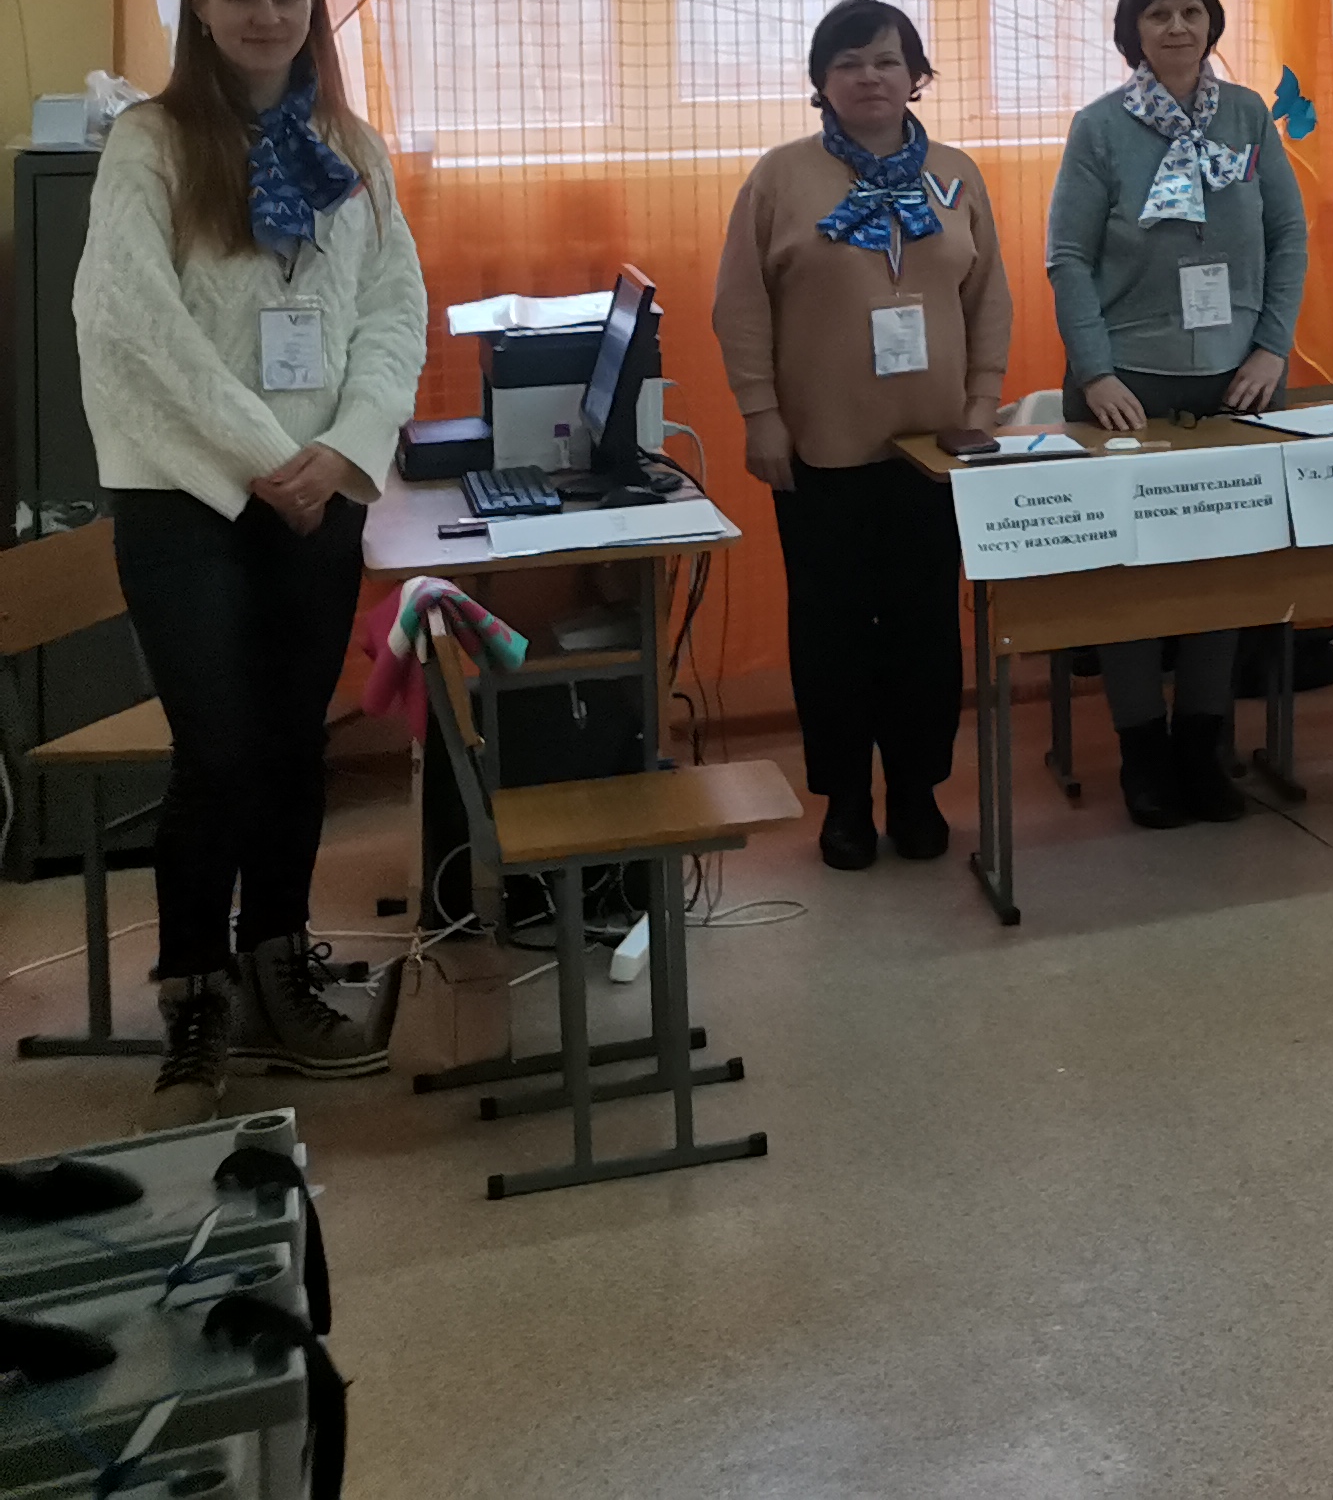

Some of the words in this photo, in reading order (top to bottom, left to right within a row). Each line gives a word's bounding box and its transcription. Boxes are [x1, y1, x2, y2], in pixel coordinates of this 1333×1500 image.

[1133, 474, 1262, 499] Дополнительный
[1014, 492, 1073, 508] Список
[1134, 506, 1178, 521] писок
[1182, 495, 1273, 517] избирателей
[986, 510, 1082, 532] избирателей
[1086, 509, 1104, 524] по
[977, 537, 1020, 553] месту
[1025, 528, 1118, 549] нахождения
